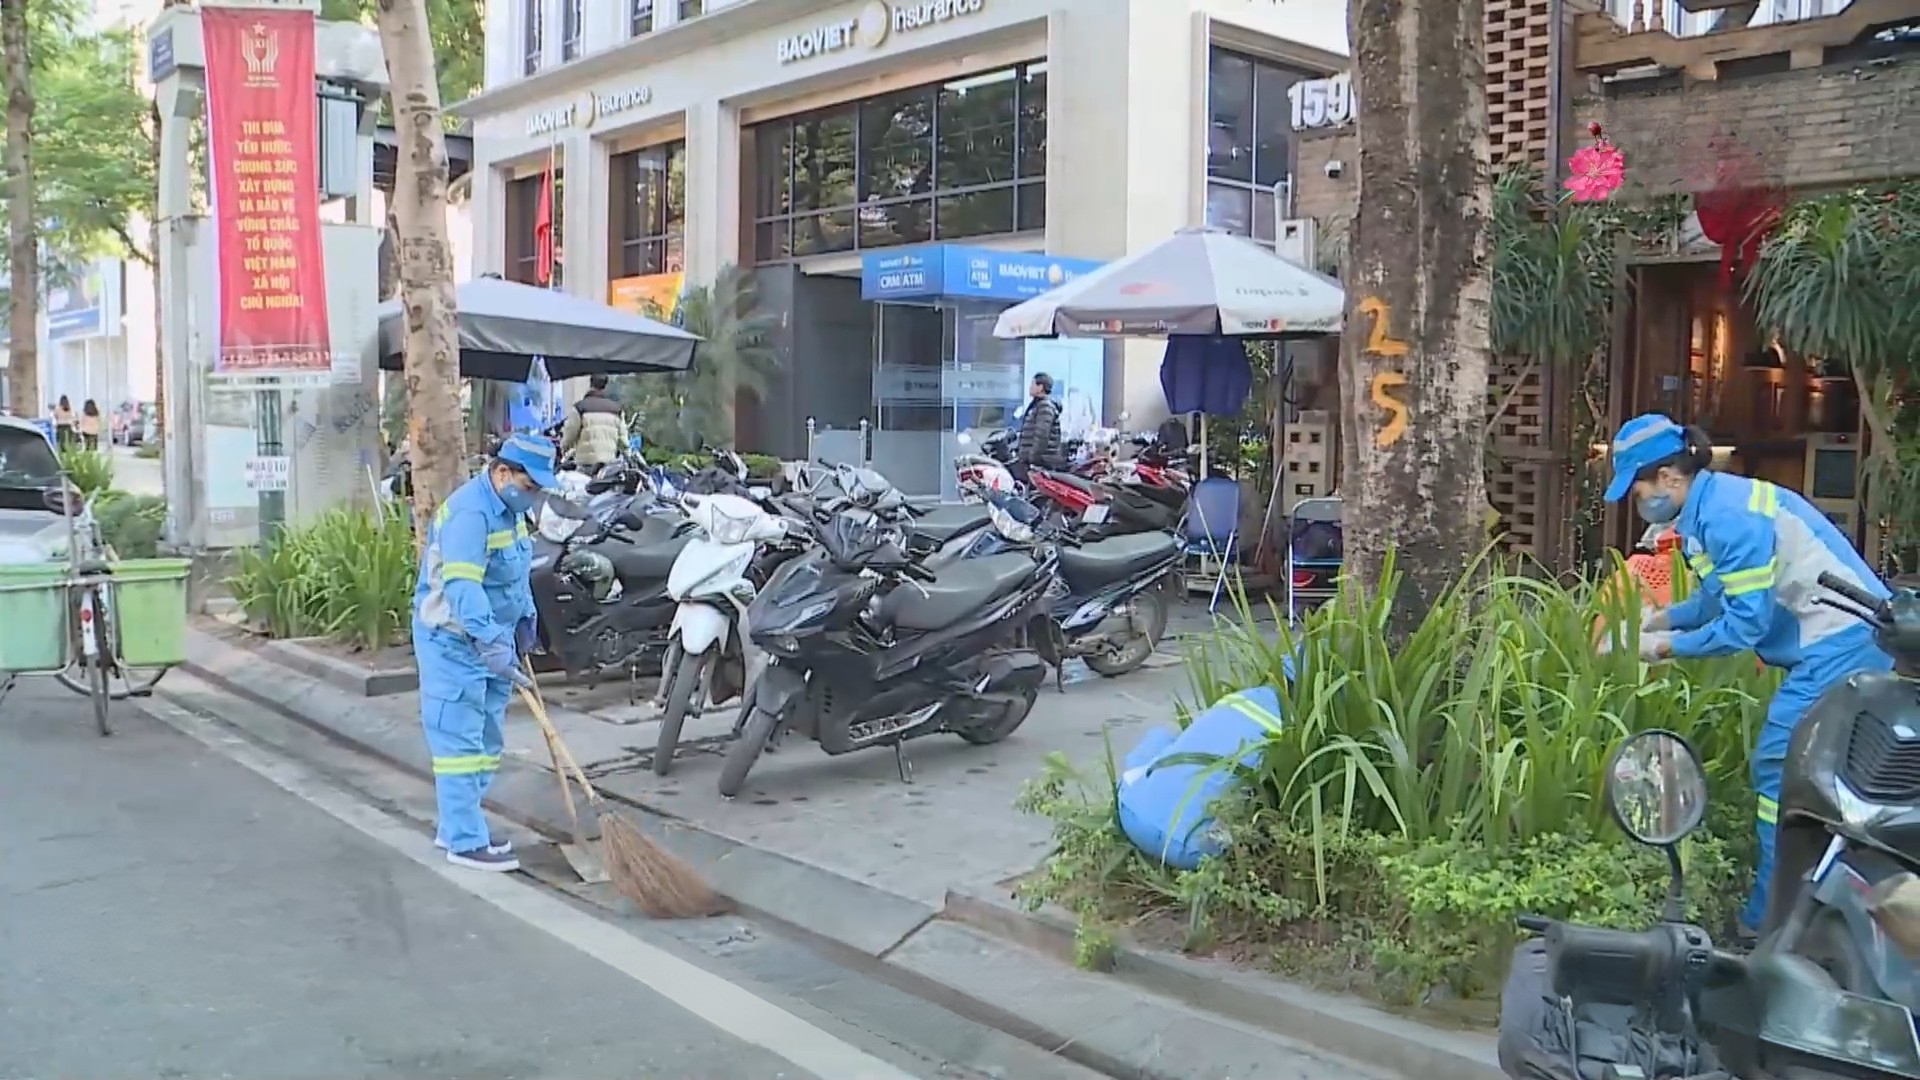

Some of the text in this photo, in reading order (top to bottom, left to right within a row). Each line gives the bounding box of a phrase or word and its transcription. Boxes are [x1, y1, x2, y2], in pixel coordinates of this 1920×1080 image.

[777, 0, 983, 65] BAOVIET Insurance
[1287, 70, 1357, 130] 159
[902, 271, 924, 287] ATM
